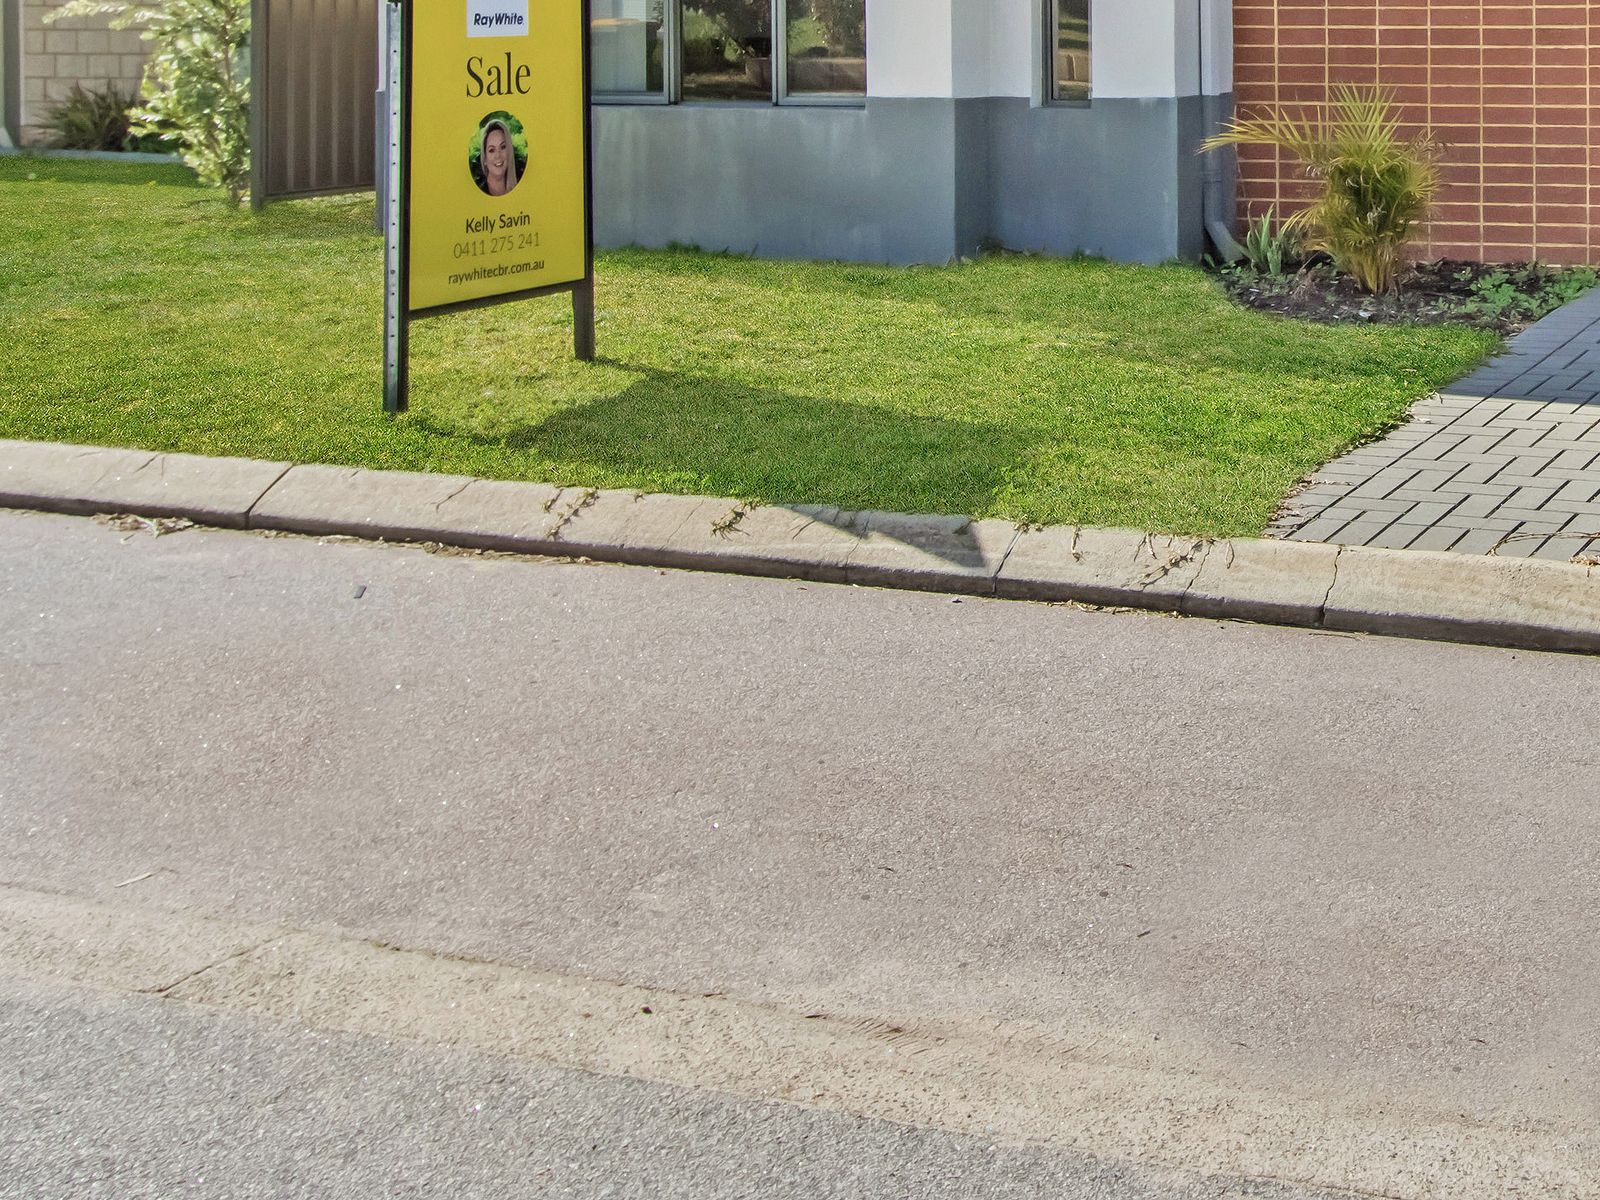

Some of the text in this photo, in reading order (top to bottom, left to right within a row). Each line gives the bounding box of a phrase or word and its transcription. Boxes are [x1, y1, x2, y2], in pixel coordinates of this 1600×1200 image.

[466, 51, 531, 98] Sale
[465, 211, 531, 234] Kelly Savin
[453, 232, 540, 259] 0411 275 241
[448, 260, 545, 285] raywhitecbr.com.au
